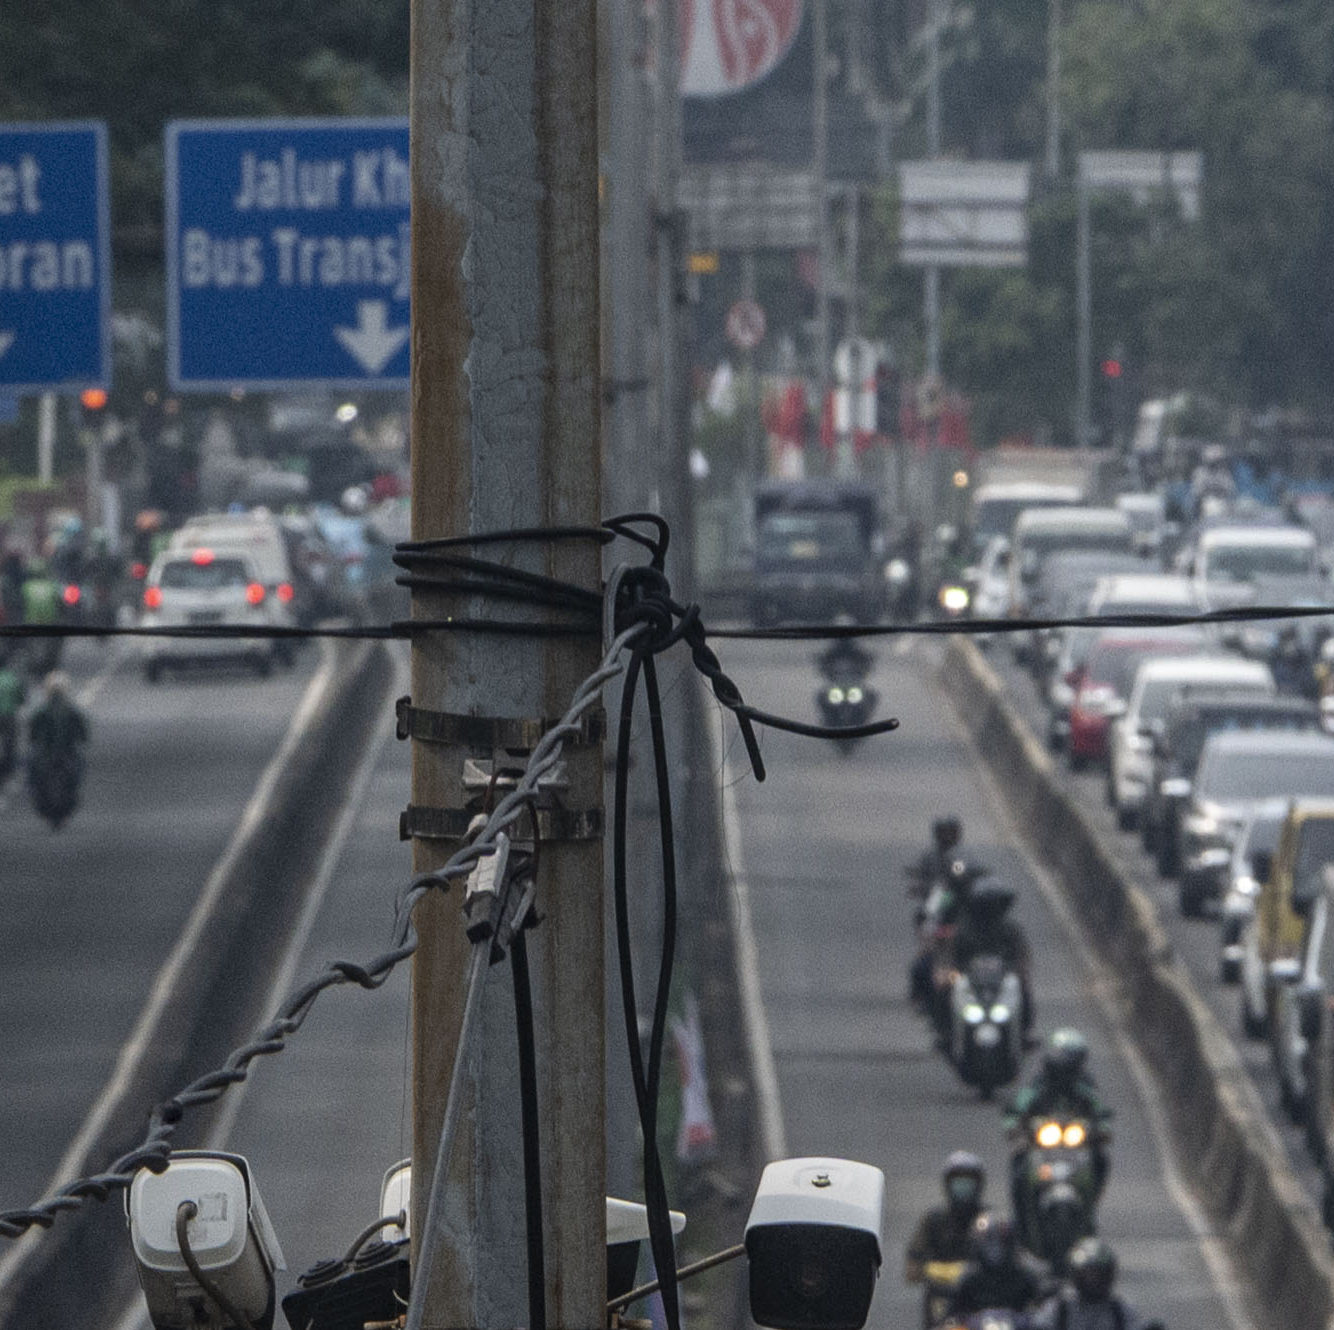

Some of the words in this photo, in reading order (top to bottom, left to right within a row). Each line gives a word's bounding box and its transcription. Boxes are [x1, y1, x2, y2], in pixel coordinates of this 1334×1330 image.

[235, 149, 345, 210] Jalur
[353, 146, 410, 207] Kh
[183, 228, 264, 286] Bus
[272, 223, 410, 298] Transj
